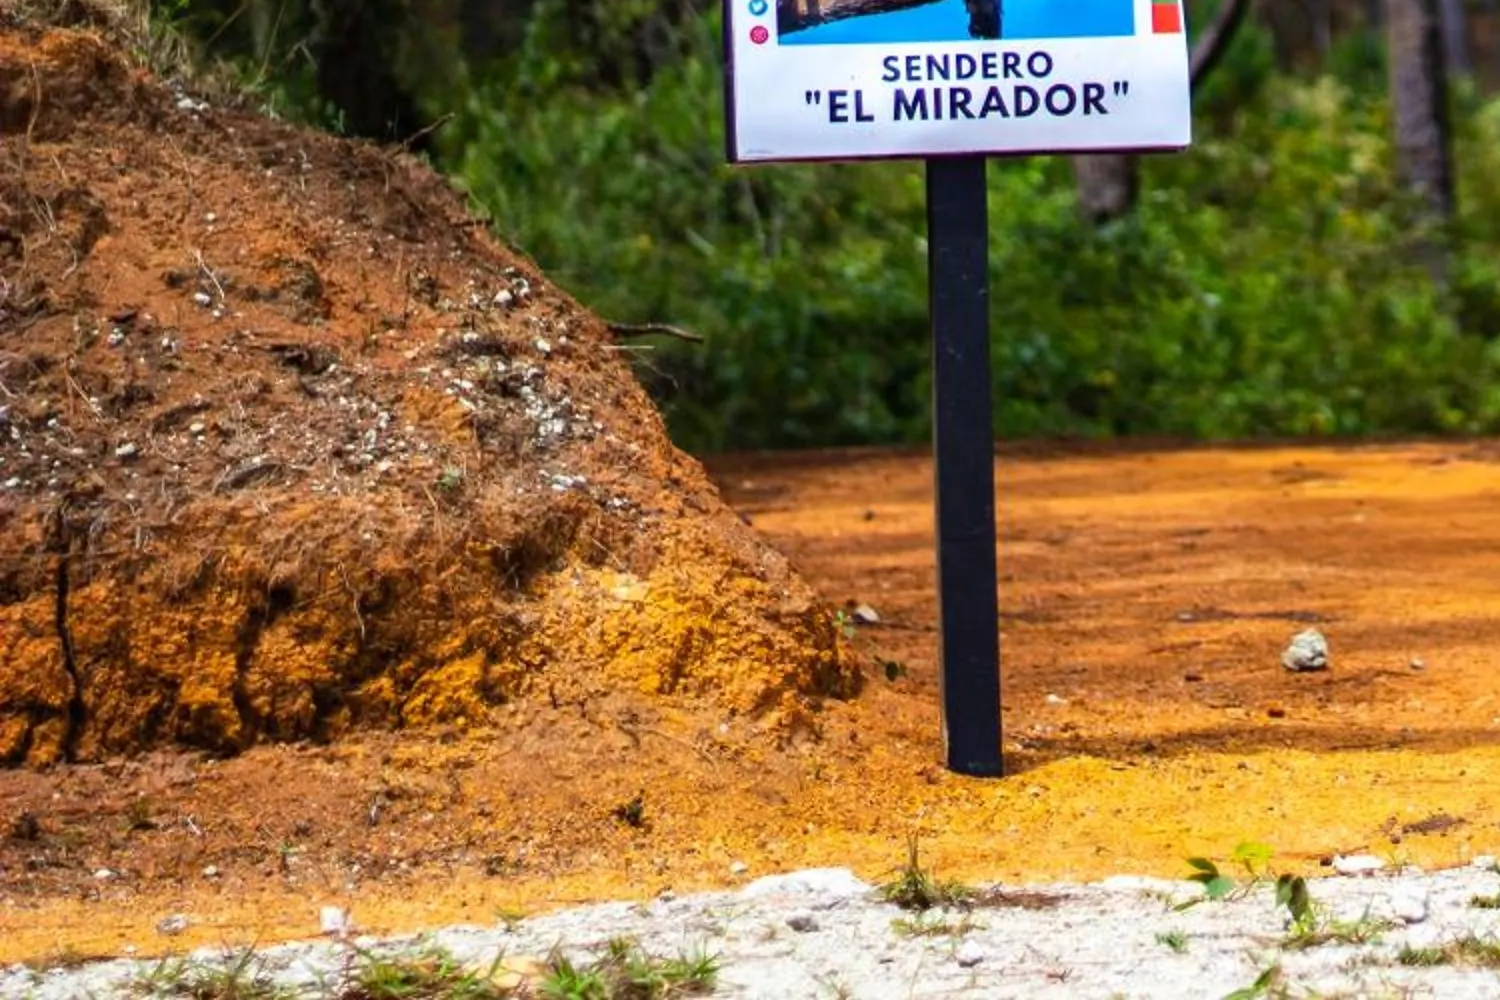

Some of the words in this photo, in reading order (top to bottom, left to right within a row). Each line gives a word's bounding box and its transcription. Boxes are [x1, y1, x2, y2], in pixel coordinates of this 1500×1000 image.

[881, 51, 1053, 81] SENDERO
[805, 90, 875, 123] "EL
[893, 81, 1129, 121] MIRADOR"
